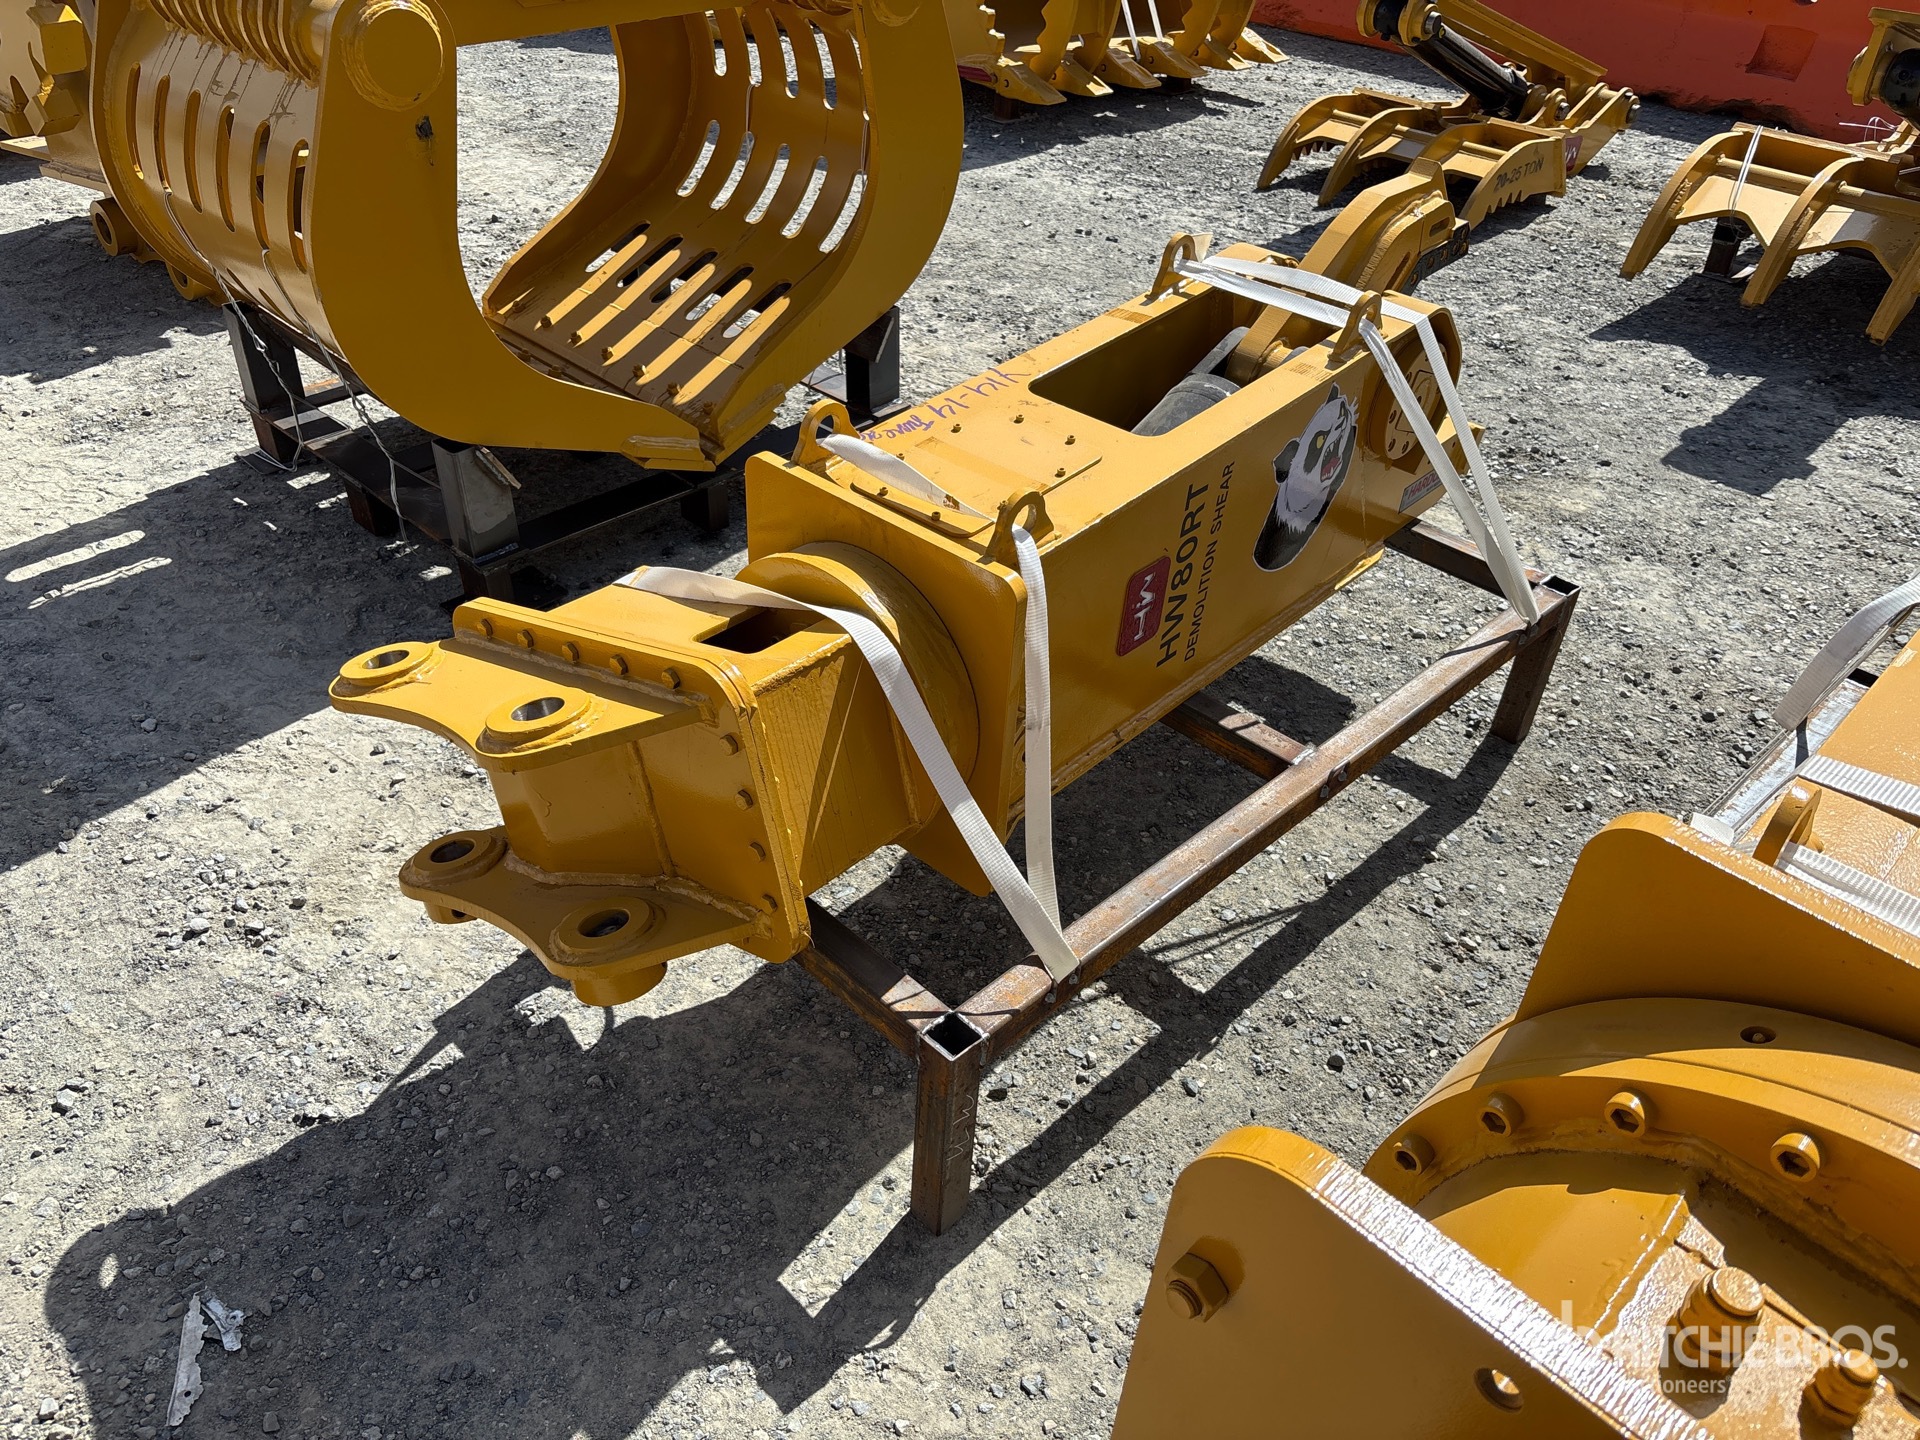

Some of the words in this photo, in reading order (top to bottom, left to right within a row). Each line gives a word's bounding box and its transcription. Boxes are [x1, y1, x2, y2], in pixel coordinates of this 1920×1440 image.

[1524, 157, 1545, 177] TON
[1407, 471, 1441, 500] HARDO
[1156, 483, 1209, 668] HW80RT
[1184, 540, 1219, 662] DEMOLITION
[1210, 460, 1236, 535] SHEAR
